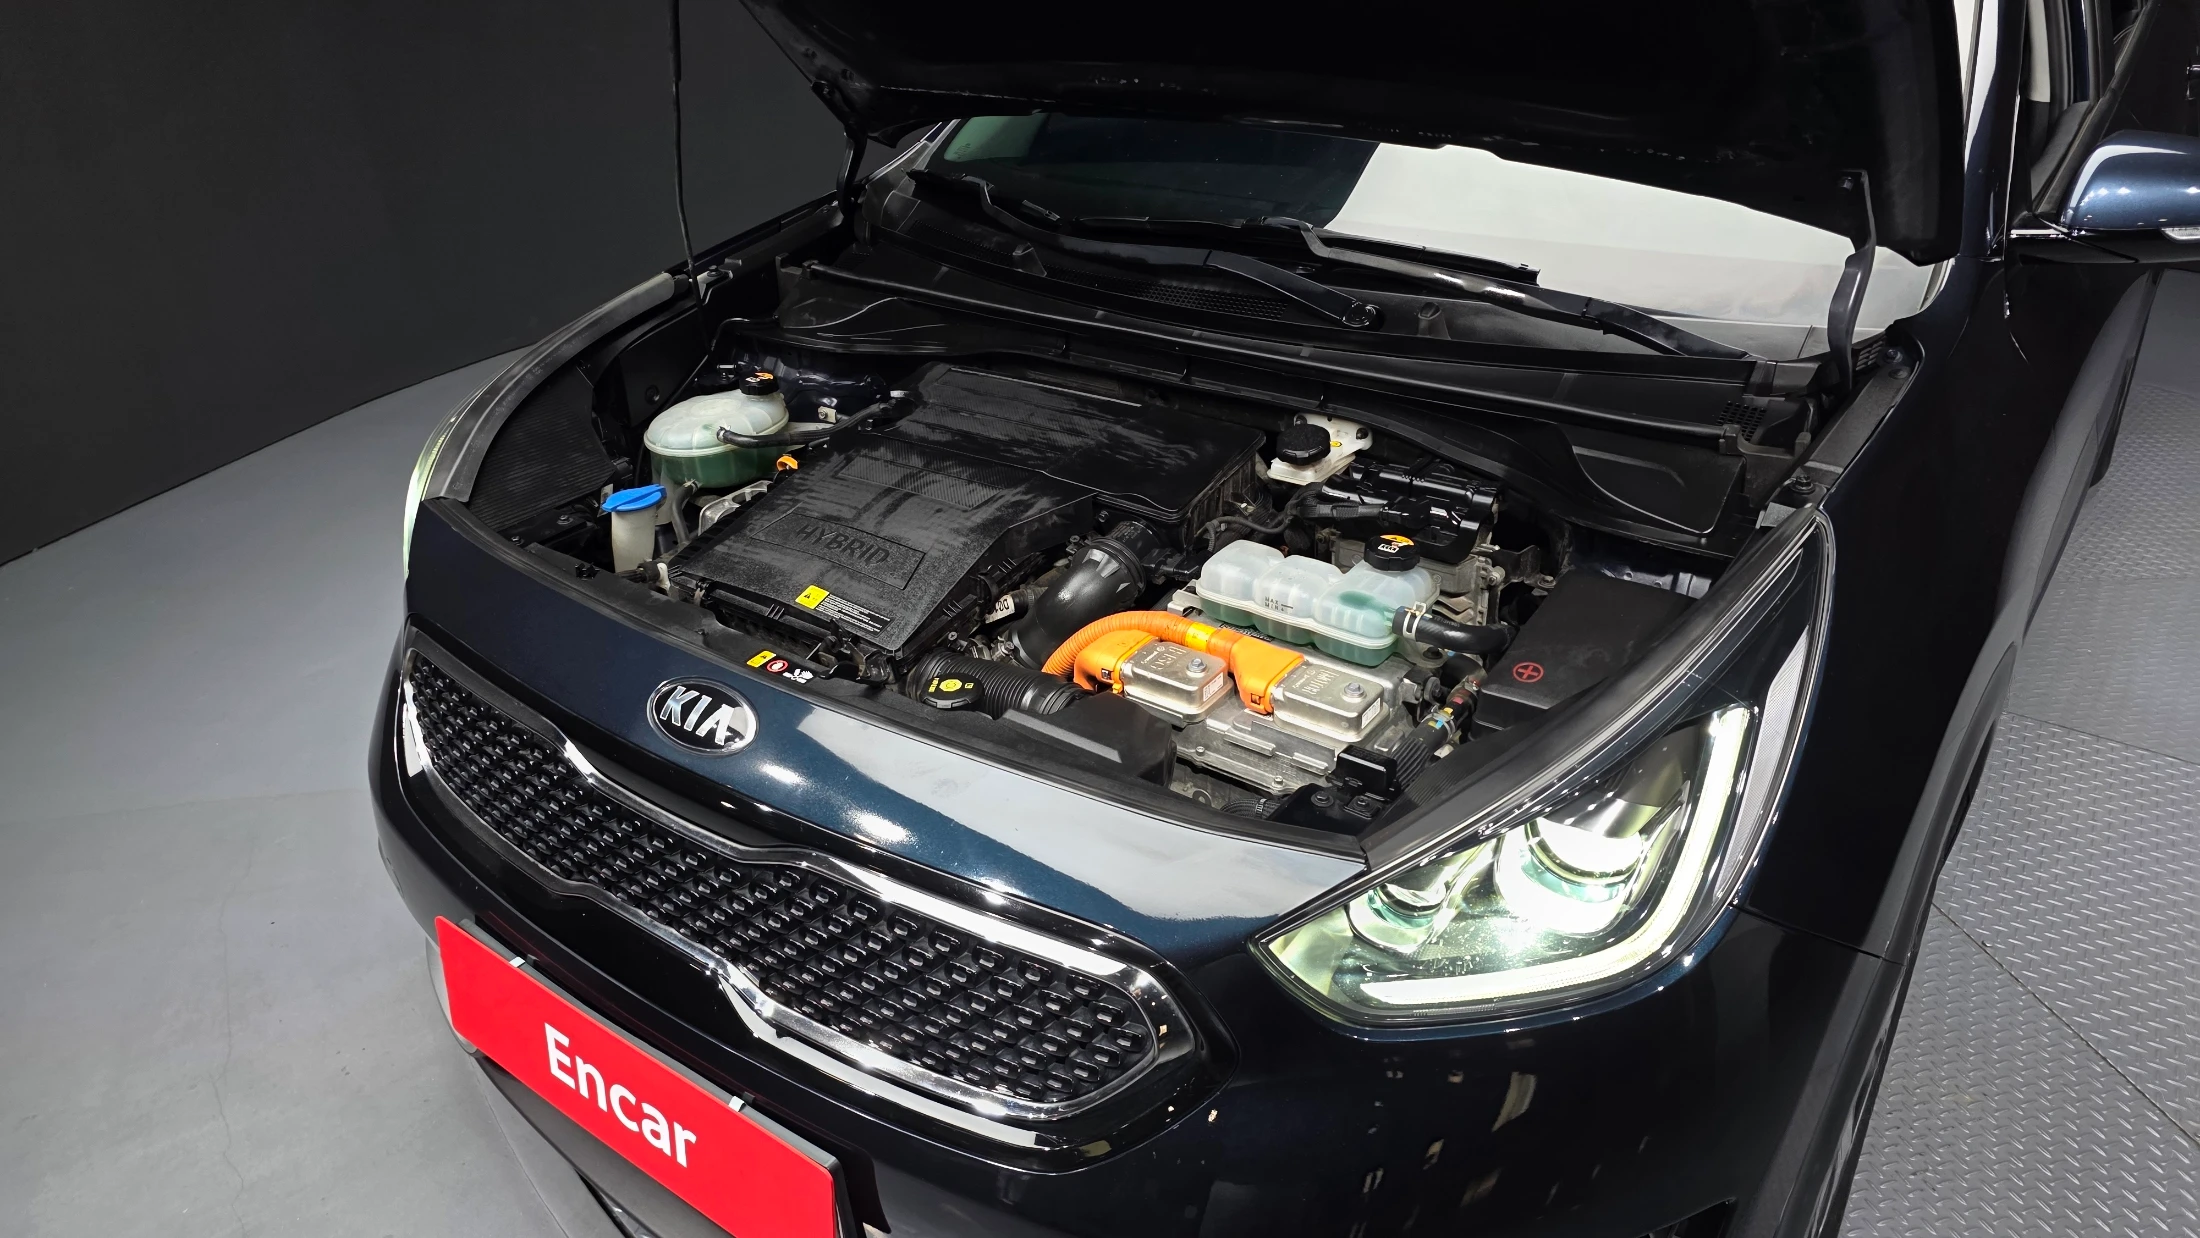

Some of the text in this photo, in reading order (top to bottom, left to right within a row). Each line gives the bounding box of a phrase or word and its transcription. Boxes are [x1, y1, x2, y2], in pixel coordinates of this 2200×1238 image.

[795, 523, 890, 566] HYBRID
[660, 685, 735, 746] KIA
[544, 1022, 697, 1168] Encar
